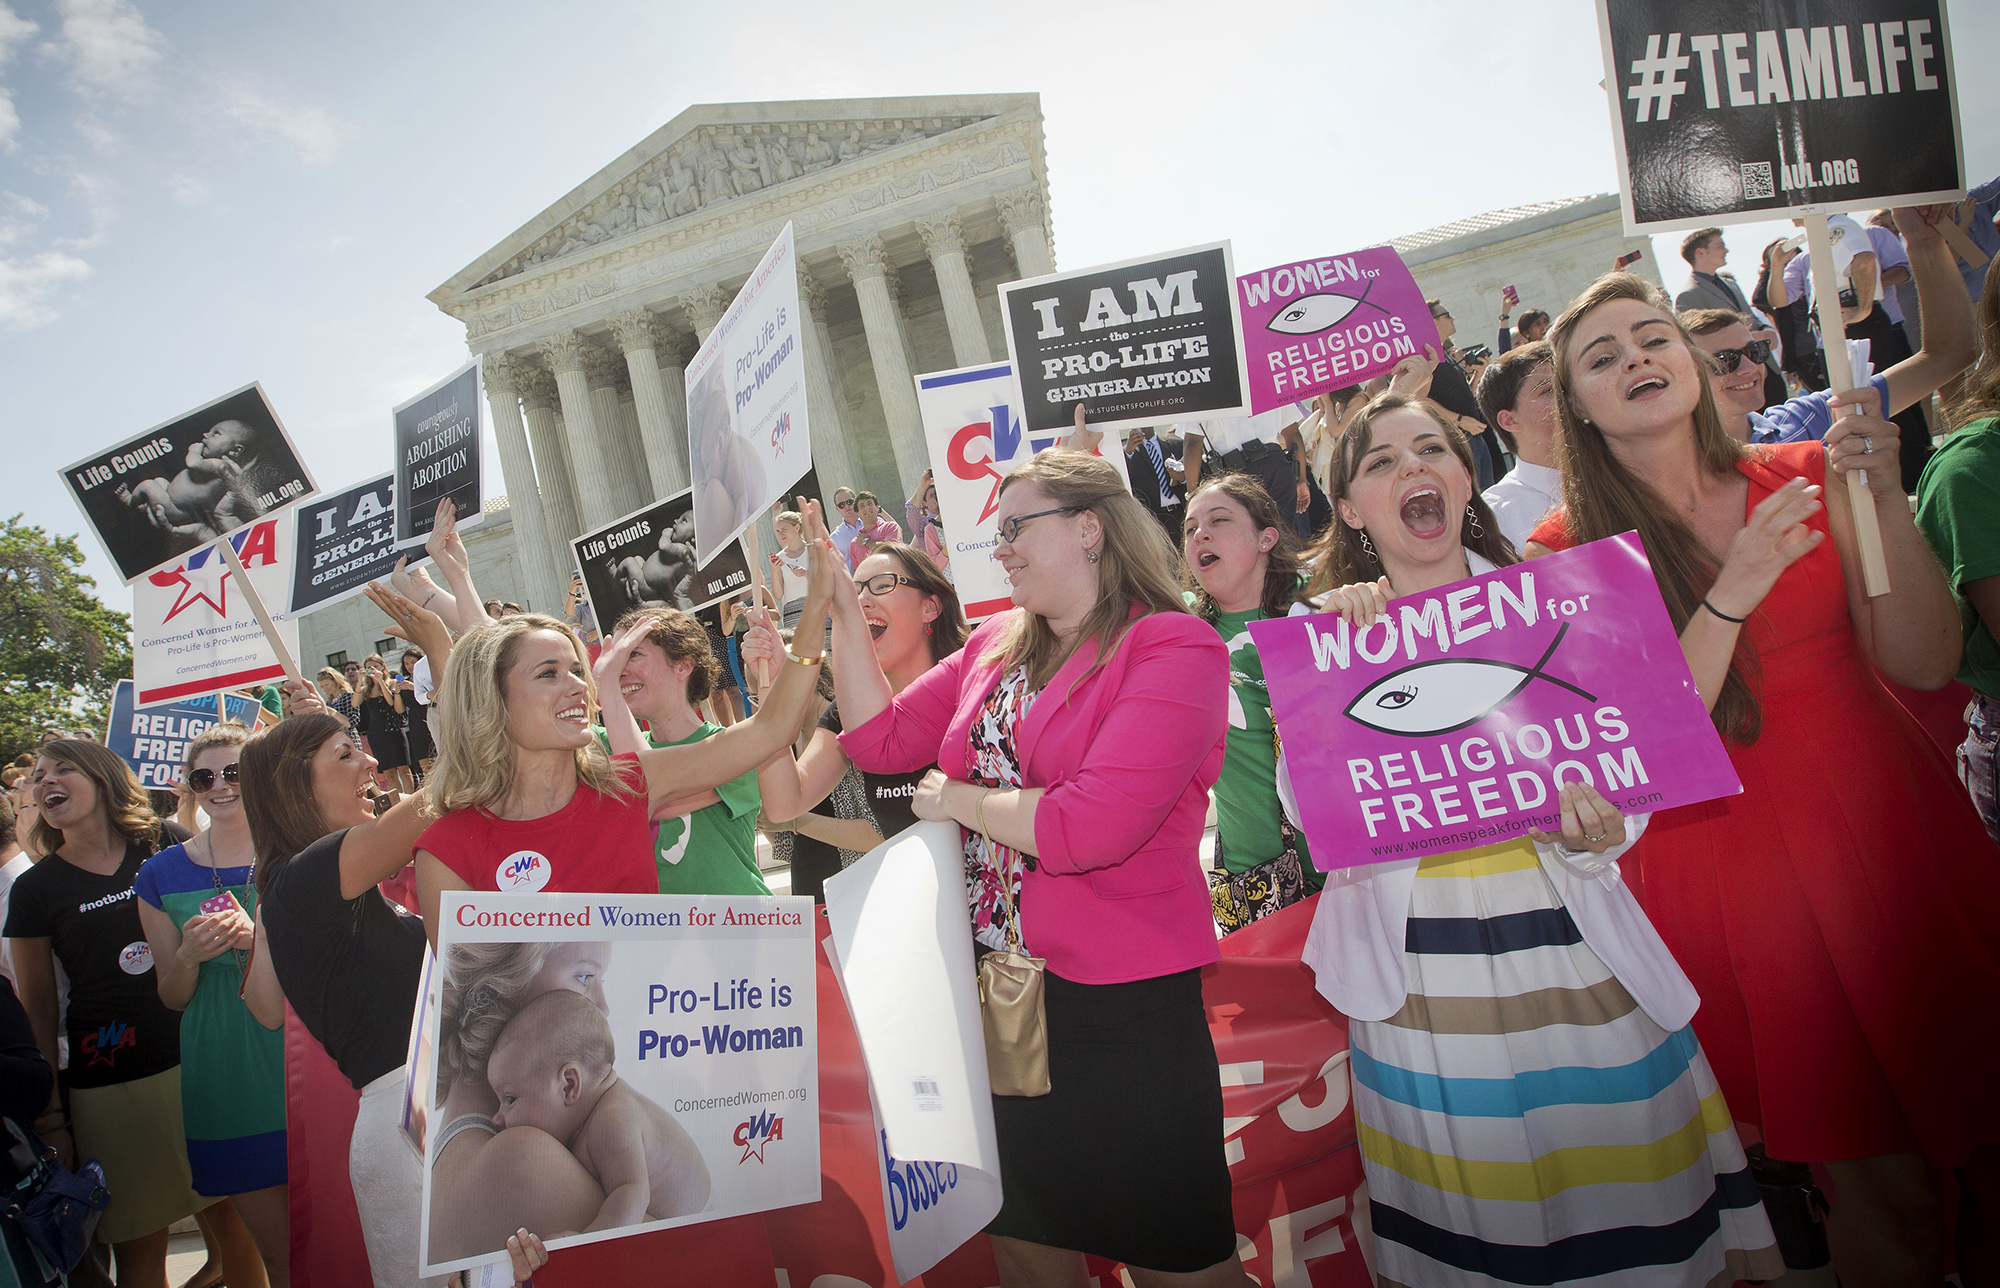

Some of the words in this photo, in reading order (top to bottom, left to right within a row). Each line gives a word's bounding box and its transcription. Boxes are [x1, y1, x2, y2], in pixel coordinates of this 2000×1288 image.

[1627, 18, 1939, 123] #TEAMLIFE
[1780, 158, 1860, 191] AUL.ORG
[1242, 257, 1360, 308] WOMEN
[1360, 267, 1381, 280] for
[688, 335, 718, 385] Concerned
[718, 303, 743, 340] Women
[744, 287, 754, 308] for
[754, 243, 787, 294] America
[1032, 297, 1065, 340] I
[1079, 270, 1204, 332] AM
[736, 320, 775, 382] Pro-Life
[776, 306, 787, 332] is
[1109, 331, 1130, 342] the
[1267, 316, 1406, 372] RELIGIOUS
[735, 334, 794, 415] Pro-Woman
[1041, 335, 1210, 380] PRO-LIFE
[1272, 335, 1416, 395] FREEDOM
[1046, 367, 1212, 404] GENERATION
[405, 417, 472, 467] ABOLISHING
[771, 411, 791, 448] CWA
[76, 463, 113, 492] Life
[111, 436, 173, 475] Counts
[411, 447, 468, 491] ABORTION
[257, 479, 305, 511] AUL.ORG
[315, 506, 338, 541] I
[367, 517, 383, 529] the
[581, 541, 607, 561] Life
[606, 519, 652, 548] Counts
[707, 570, 747, 596] AUL.ORG
[141, 630, 194, 649] Concerned
[196, 623, 233, 637] Women
[234, 619, 249, 631] for
[1304, 571, 1539, 673] WOMEN
[1546, 592, 1591, 620] for
[167, 642, 202, 657] Pro-Life
[203, 641, 211, 650] is
[176, 653, 257, 675] ConcernedWomen.org
[1346, 706, 1630, 794] RELIGIOUS
[1359, 746, 1650, 838] FREEDOM
[504, 856, 541, 878] CWA
[456, 904, 590, 928] Concerned
[598, 905, 682, 928] Women
[688, 905, 717, 928] for
[721, 906, 802, 927] America
[125, 944, 151, 960] CWA
[648, 978, 763, 1015] Pro-Life
[770, 977, 793, 1008] is
[81, 1021, 136, 1052] CWA
[638, 1024, 804, 1060] Pro-Woman
[674, 1086, 807, 1114] ConcernedWomen.org
[732, 1108, 784, 1147] CWA
